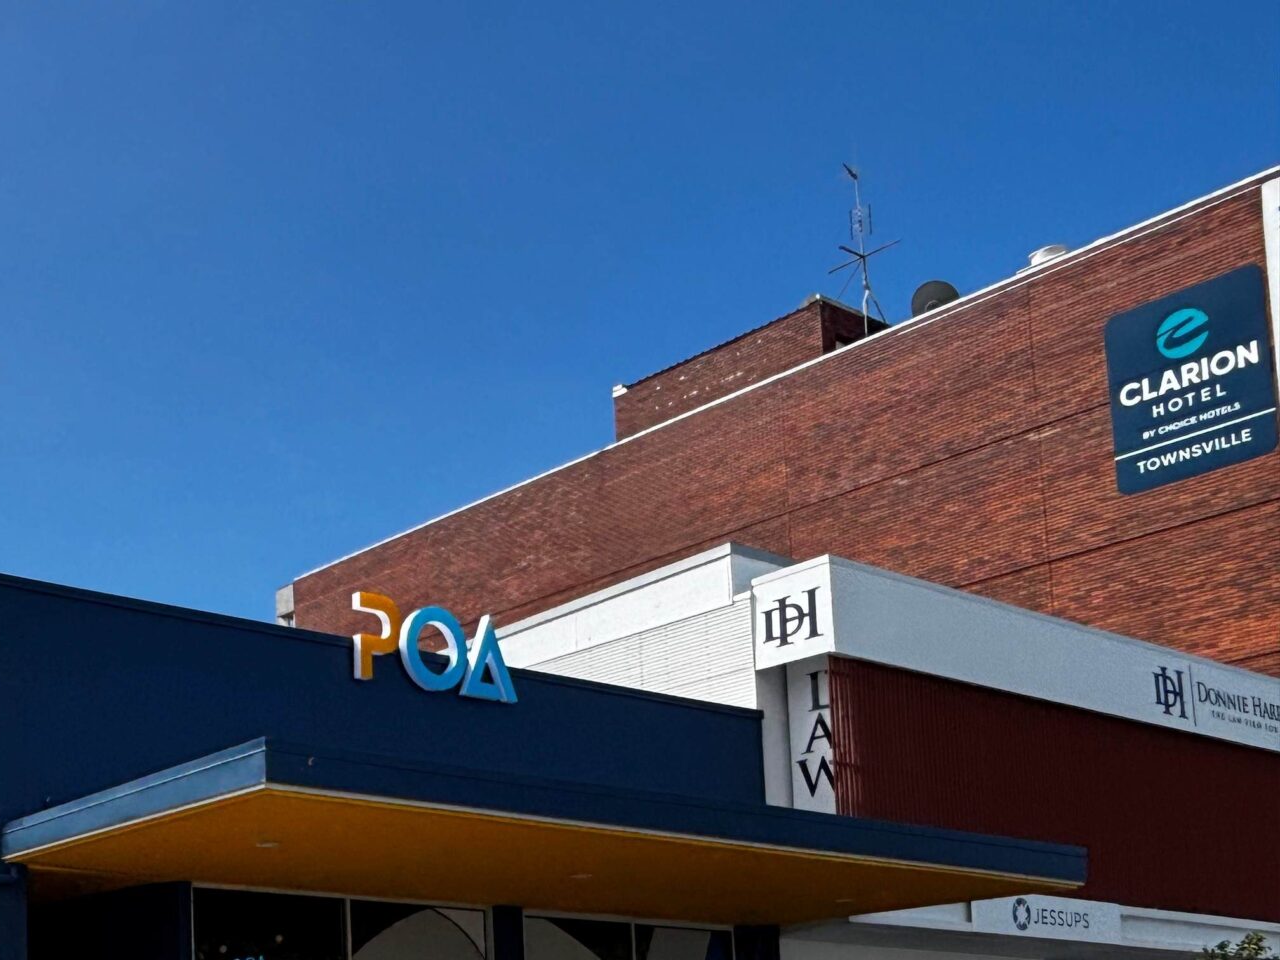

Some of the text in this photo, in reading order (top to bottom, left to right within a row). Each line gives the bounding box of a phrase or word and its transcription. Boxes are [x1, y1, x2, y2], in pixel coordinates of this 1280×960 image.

[1120, 340, 1260, 407] CLARION
[1152, 383, 1227, 418] HOTEL
[1142, 401, 1241, 440] BY CHOICE HOTELS
[1136, 428, 1253, 474] TOWNSVILLE
[351, 591, 518, 704] POA
[1196, 681, 1250, 714] DONNIE
[1033, 908, 1090, 928] JESSUPS
